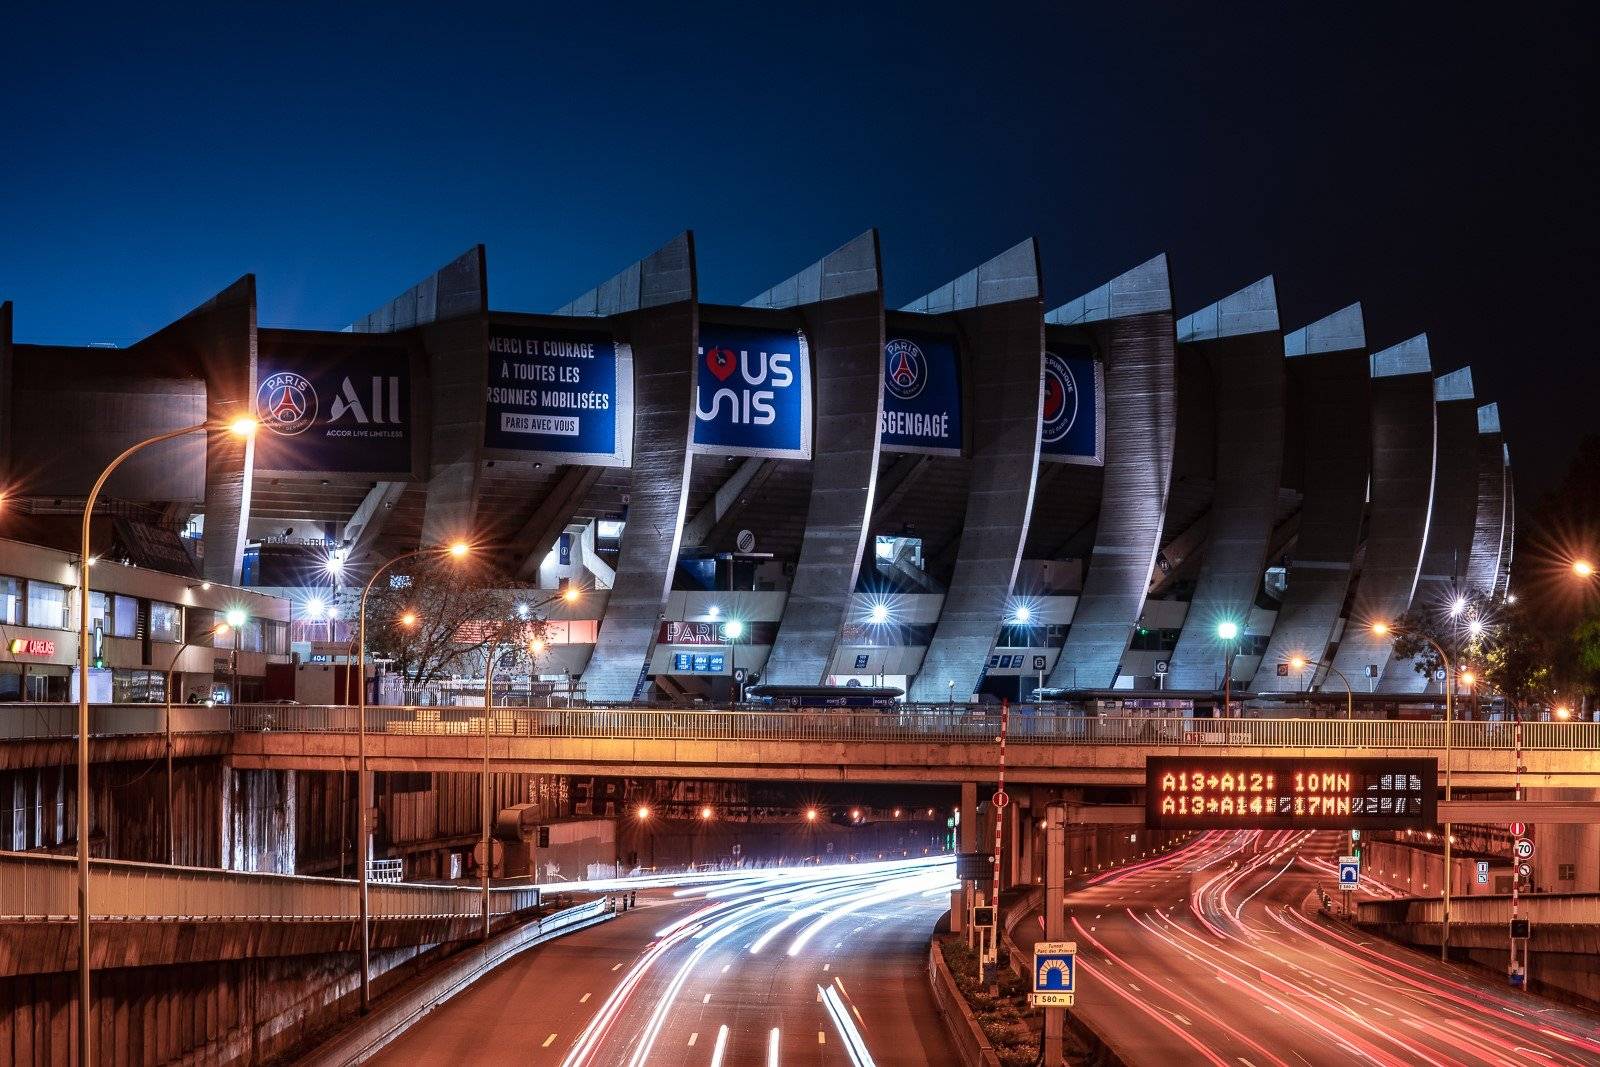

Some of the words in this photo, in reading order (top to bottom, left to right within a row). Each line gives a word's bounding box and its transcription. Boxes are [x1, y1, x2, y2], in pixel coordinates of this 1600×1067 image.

[487, 336, 522, 354] MERCI
[526, 339, 539, 356] ET
[543, 341, 595, 359] COURAGE
[887, 341, 919, 358] PARIS
[501, 360, 509, 379] À
[513, 363, 556, 382] TOUTES
[559, 366, 580, 383] LES
[266, 374, 309, 392] PARIS
[541, 390, 609, 410] MOBILISÉES
[505, 416, 529, 429] PARIS
[531, 418, 552, 430] AVEC
[554, 420, 575, 432] VOUS
[326, 429, 353, 437] ACCOR
[353, 429, 368, 438] LIVE
[369, 430, 404, 439] LIMITLESS
[1518, 844, 1531, 854] 70
[1042, 995, 1057, 1003] 580
